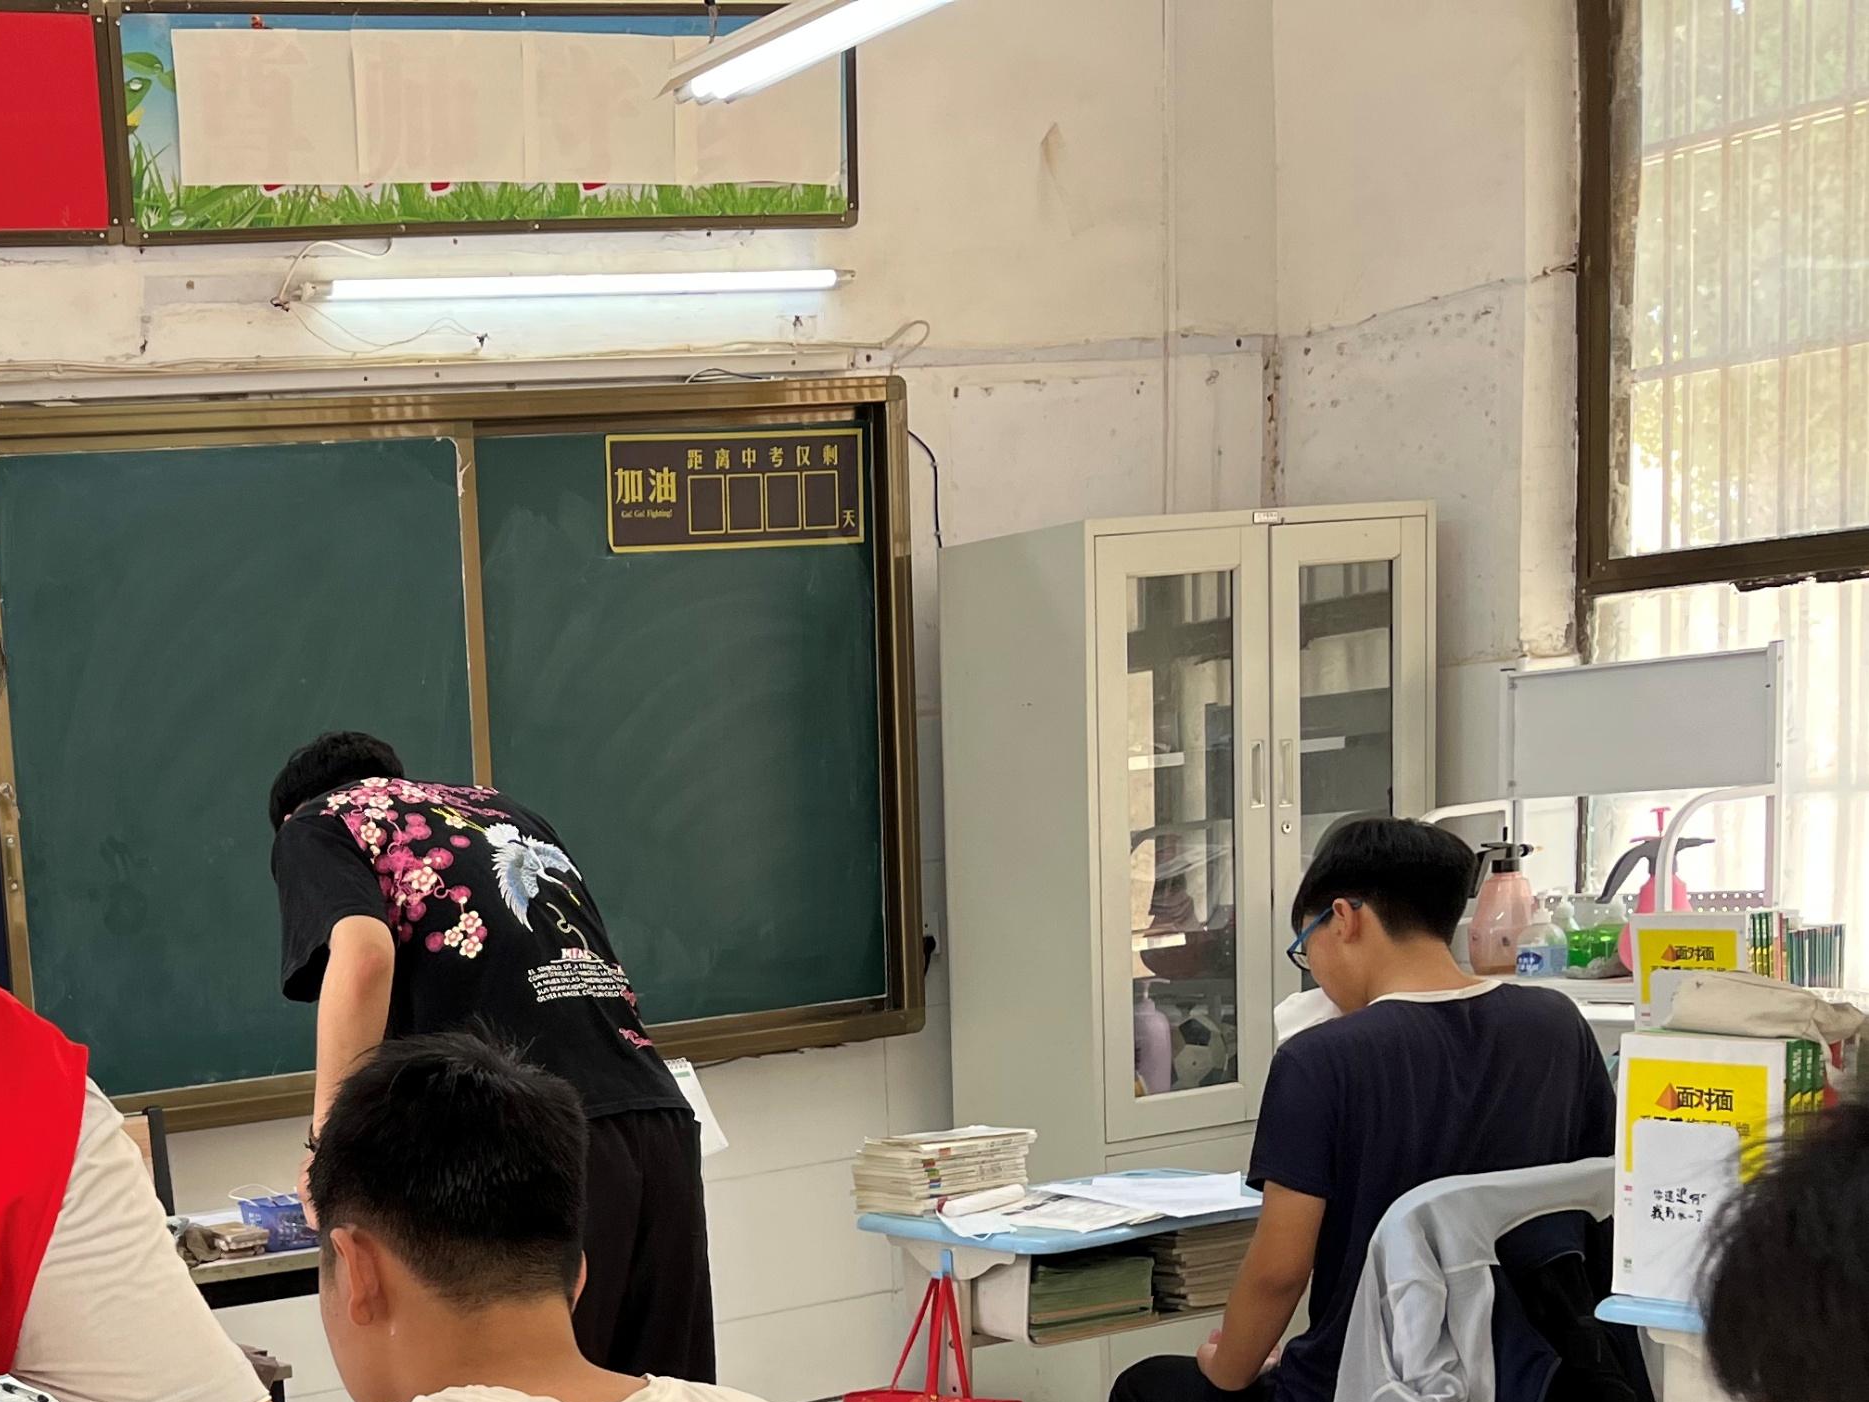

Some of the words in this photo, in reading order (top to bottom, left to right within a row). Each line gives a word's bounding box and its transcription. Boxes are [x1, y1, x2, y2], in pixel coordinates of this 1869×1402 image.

[686, 443, 841, 471] 距离中考仅剩
[614, 466, 678, 505] 加油
[842, 510, 856, 529] 天
[1674, 945, 1715, 963] 面对面
[1676, 1086, 1734, 1112] 面对面
